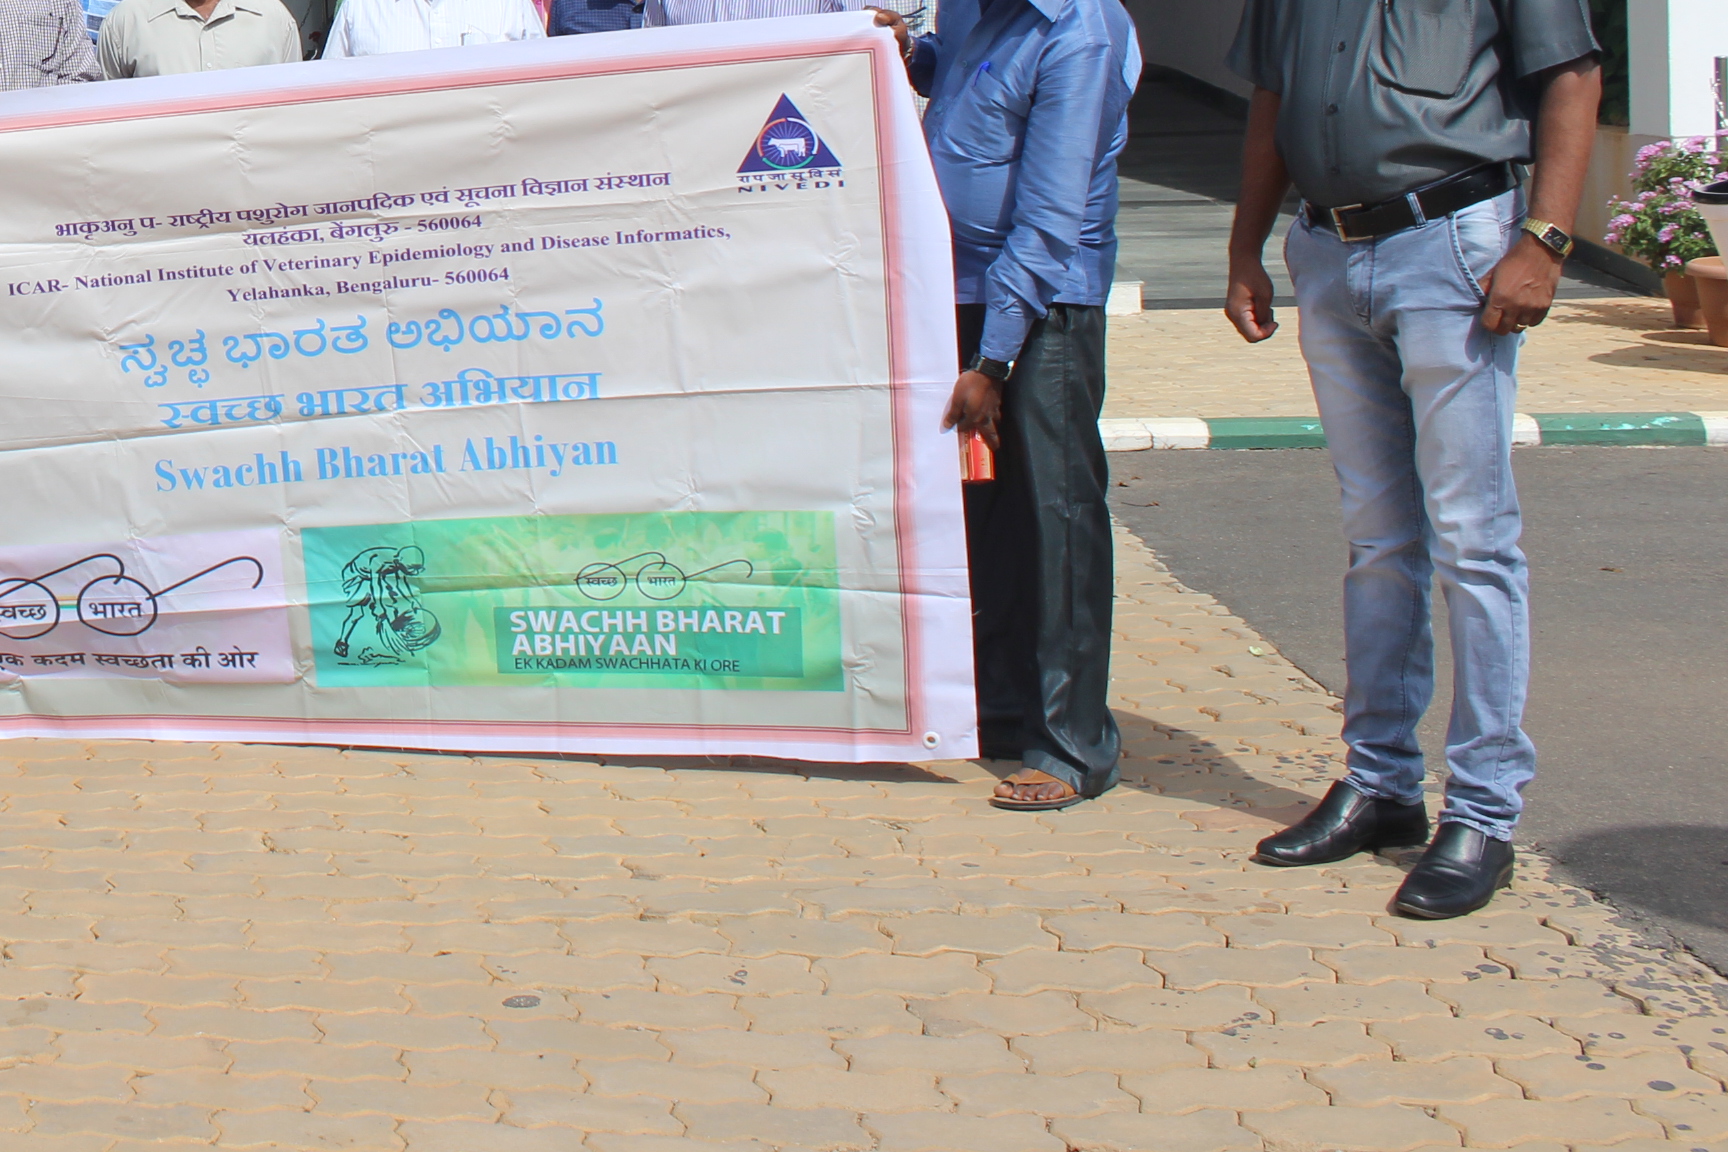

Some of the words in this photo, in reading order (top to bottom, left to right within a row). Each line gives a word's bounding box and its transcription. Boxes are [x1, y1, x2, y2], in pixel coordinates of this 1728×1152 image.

[738, 180, 845, 193] NIVEDI
[167, 208, 232, 229] राष्ट्रीय
[235, 202, 309, 224] पशुरोग
[313, 189, 415, 214] जानपदिक
[421, 186, 449, 205] एवं
[454, 183, 517, 208] सूचना
[521, 175, 589, 197] विज्ञान
[593, 170, 672, 191] संस्थान
[417, 214, 483, 233] 560064
[7, 280, 69, 297] ICAR-
[74, 270, 152, 291] National
[157, 264, 235, 282] Institute
[239, 259, 258, 275] of
[261, 252, 363, 274] Veterinary
[368, 237, 495, 266] Epidemiology
[500, 238, 535, 253] and
[540, 232, 611, 250] Disease
[615, 225, 732, 245] Informatics,
[226, 284, 331, 303] Yelahanka,
[336, 274, 439, 294] Bengaluru-
[444, 267, 509, 286] 560064
[222, 314, 369, 369] ಭಾರತ
[385, 296, 604, 354] ಅಭಿಯಾನ
[157, 391, 286, 429] स्वच्छ
[297, 382, 408, 418] भारत
[420, 366, 604, 408] अभियान
[153, 448, 305, 493] Swachh
[316, 443, 447, 481] Bharat
[459, 434, 619, 477] Abhiyan
[647, 576, 676, 587] भारत
[89, 601, 142, 618] भारत
[510, 610, 647, 633] SWACHH
[656, 611, 786, 635] BHARAT
[31, 652, 86, 667] कदम
[92, 653, 174, 669] स्वच्छता
[180, 645, 211, 669] की
[218, 645, 259, 669] ओर
[511, 634, 678, 657] ABHIYAAN
[514, 657, 533, 669] EK
[536, 657, 592, 669] KADAM
[595, 657, 691, 671] SWACHHATA
[693, 659, 707, 672] KI
[710, 659, 740, 672] ORE
